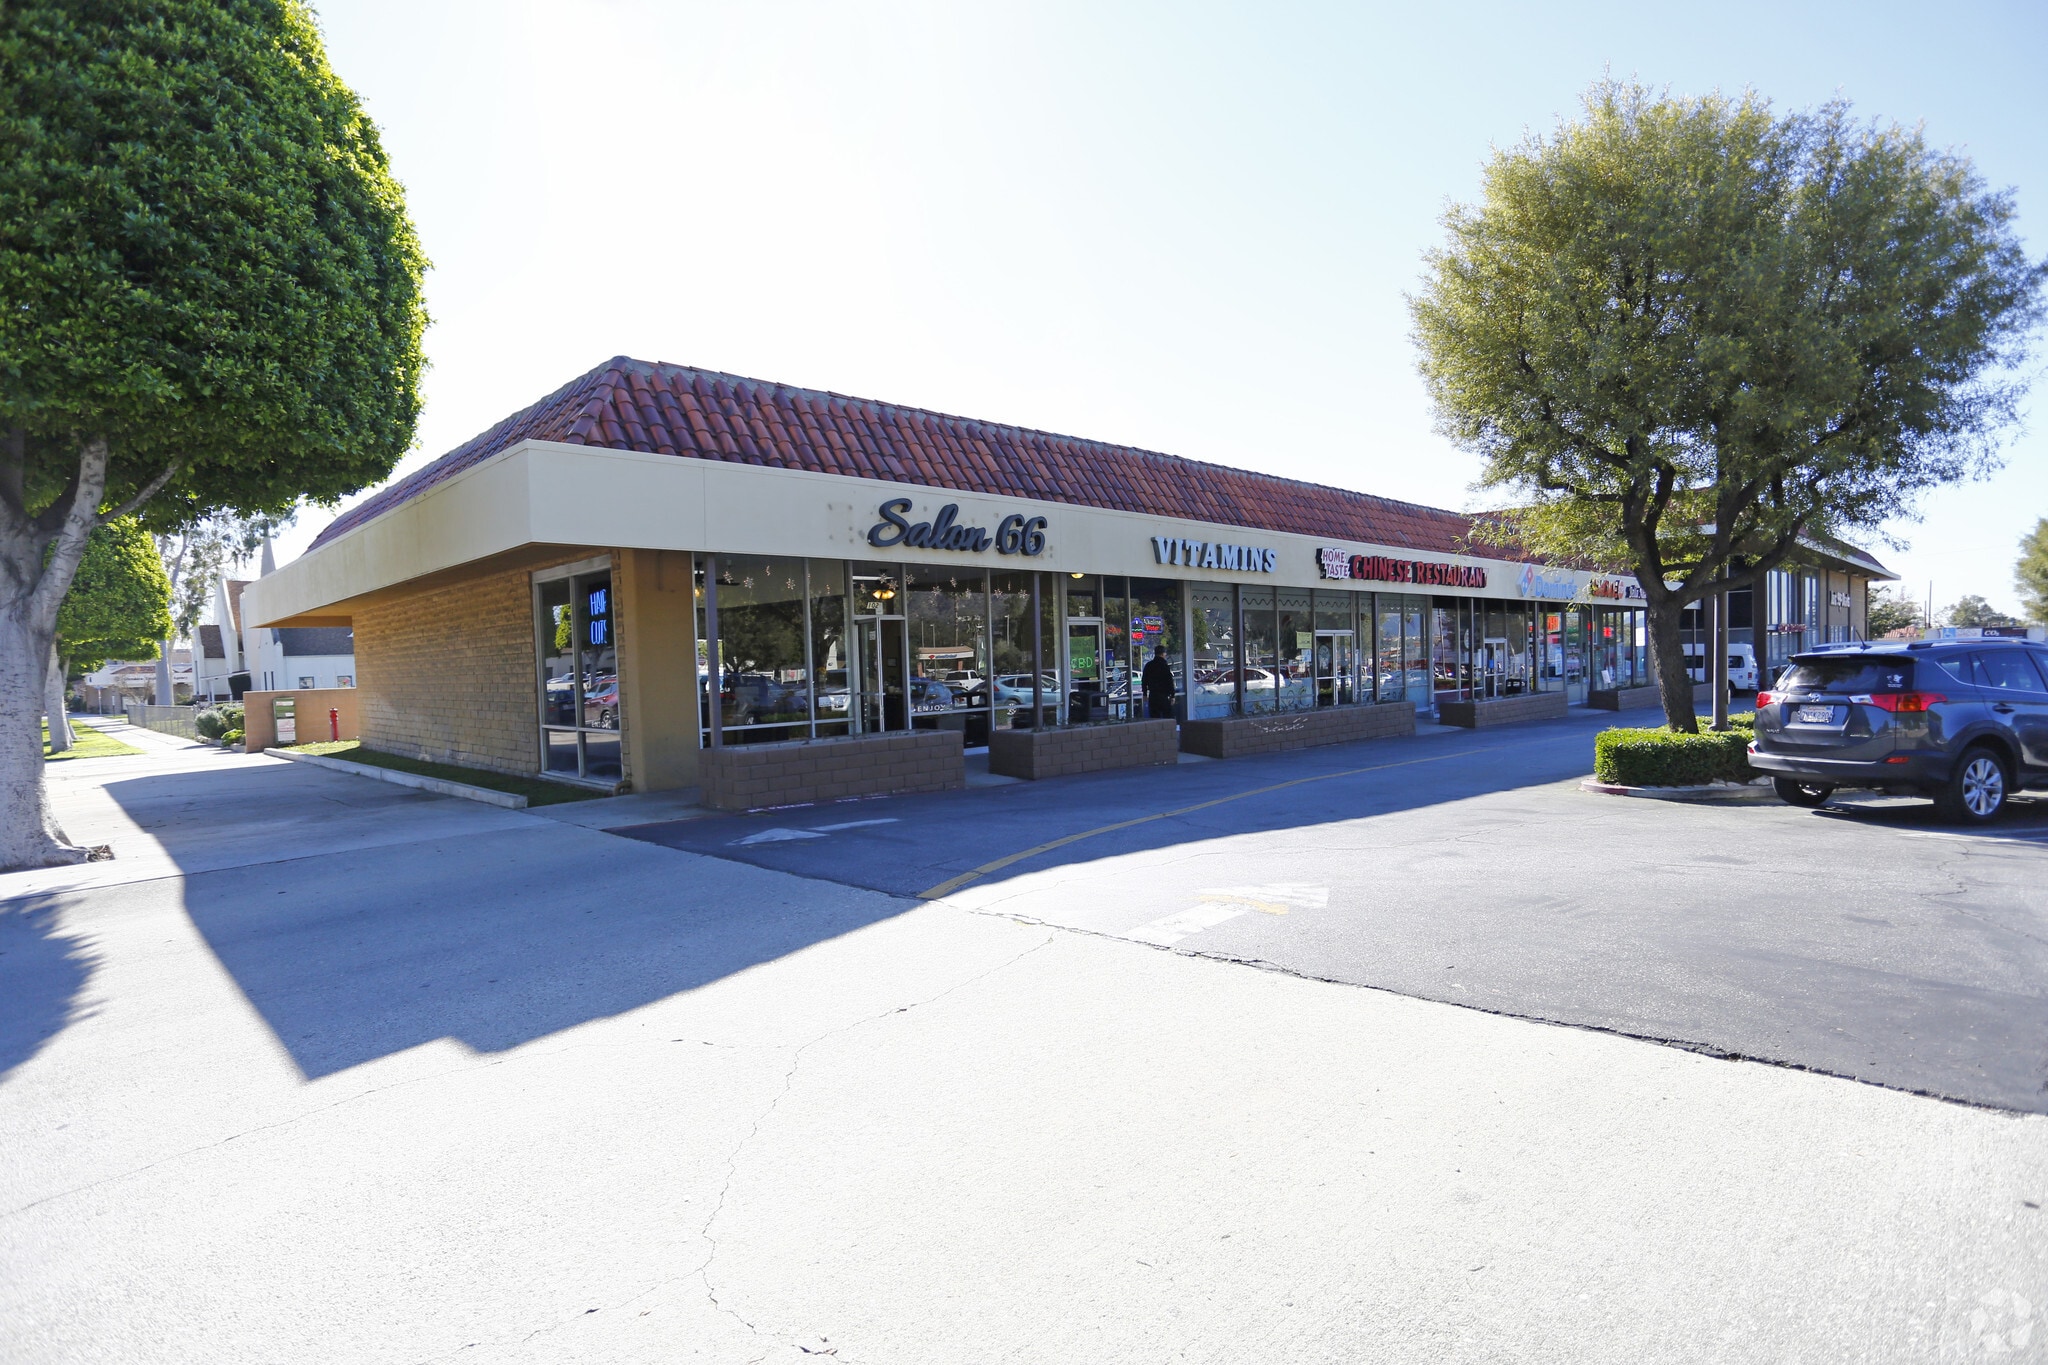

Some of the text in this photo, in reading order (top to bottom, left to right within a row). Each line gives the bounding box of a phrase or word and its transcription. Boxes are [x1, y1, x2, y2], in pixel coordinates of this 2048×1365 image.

[867, 498, 1048, 556] Salon 66
[1151, 536, 1278, 573] VITAMINS
[1322, 551, 1346, 564] HOME
[1326, 564, 1349, 577] TASTE
[1351, 555, 1490, 588] CHINESE RESTAURANT
[1070, 656, 1093, 669] CBD
[917, 704, 946, 712] ENJOY
